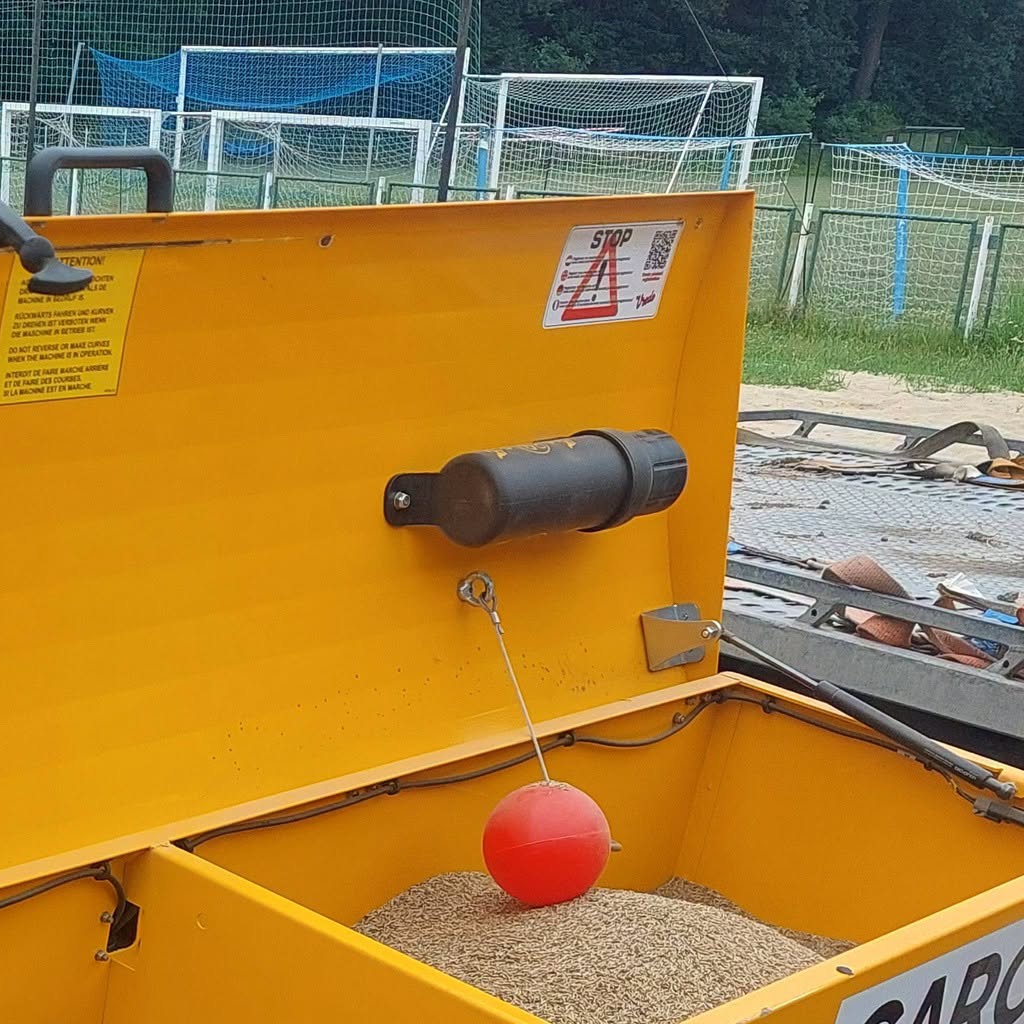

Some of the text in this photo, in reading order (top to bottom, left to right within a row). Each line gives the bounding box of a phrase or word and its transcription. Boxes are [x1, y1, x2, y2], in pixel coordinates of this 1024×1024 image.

[590, 228, 633, 249] STOP
[58, 255, 106, 267] TTENTION!
[8, 346, 18, 354] DO
[19, 345, 31, 353] NOT
[32, 343, 59, 352] REVERSE
[70, 341, 86, 349] MAKE
[86, 340, 110, 348] CURVES
[7, 355, 26, 363] WHEN
[39, 352, 65, 360] MACHINE
